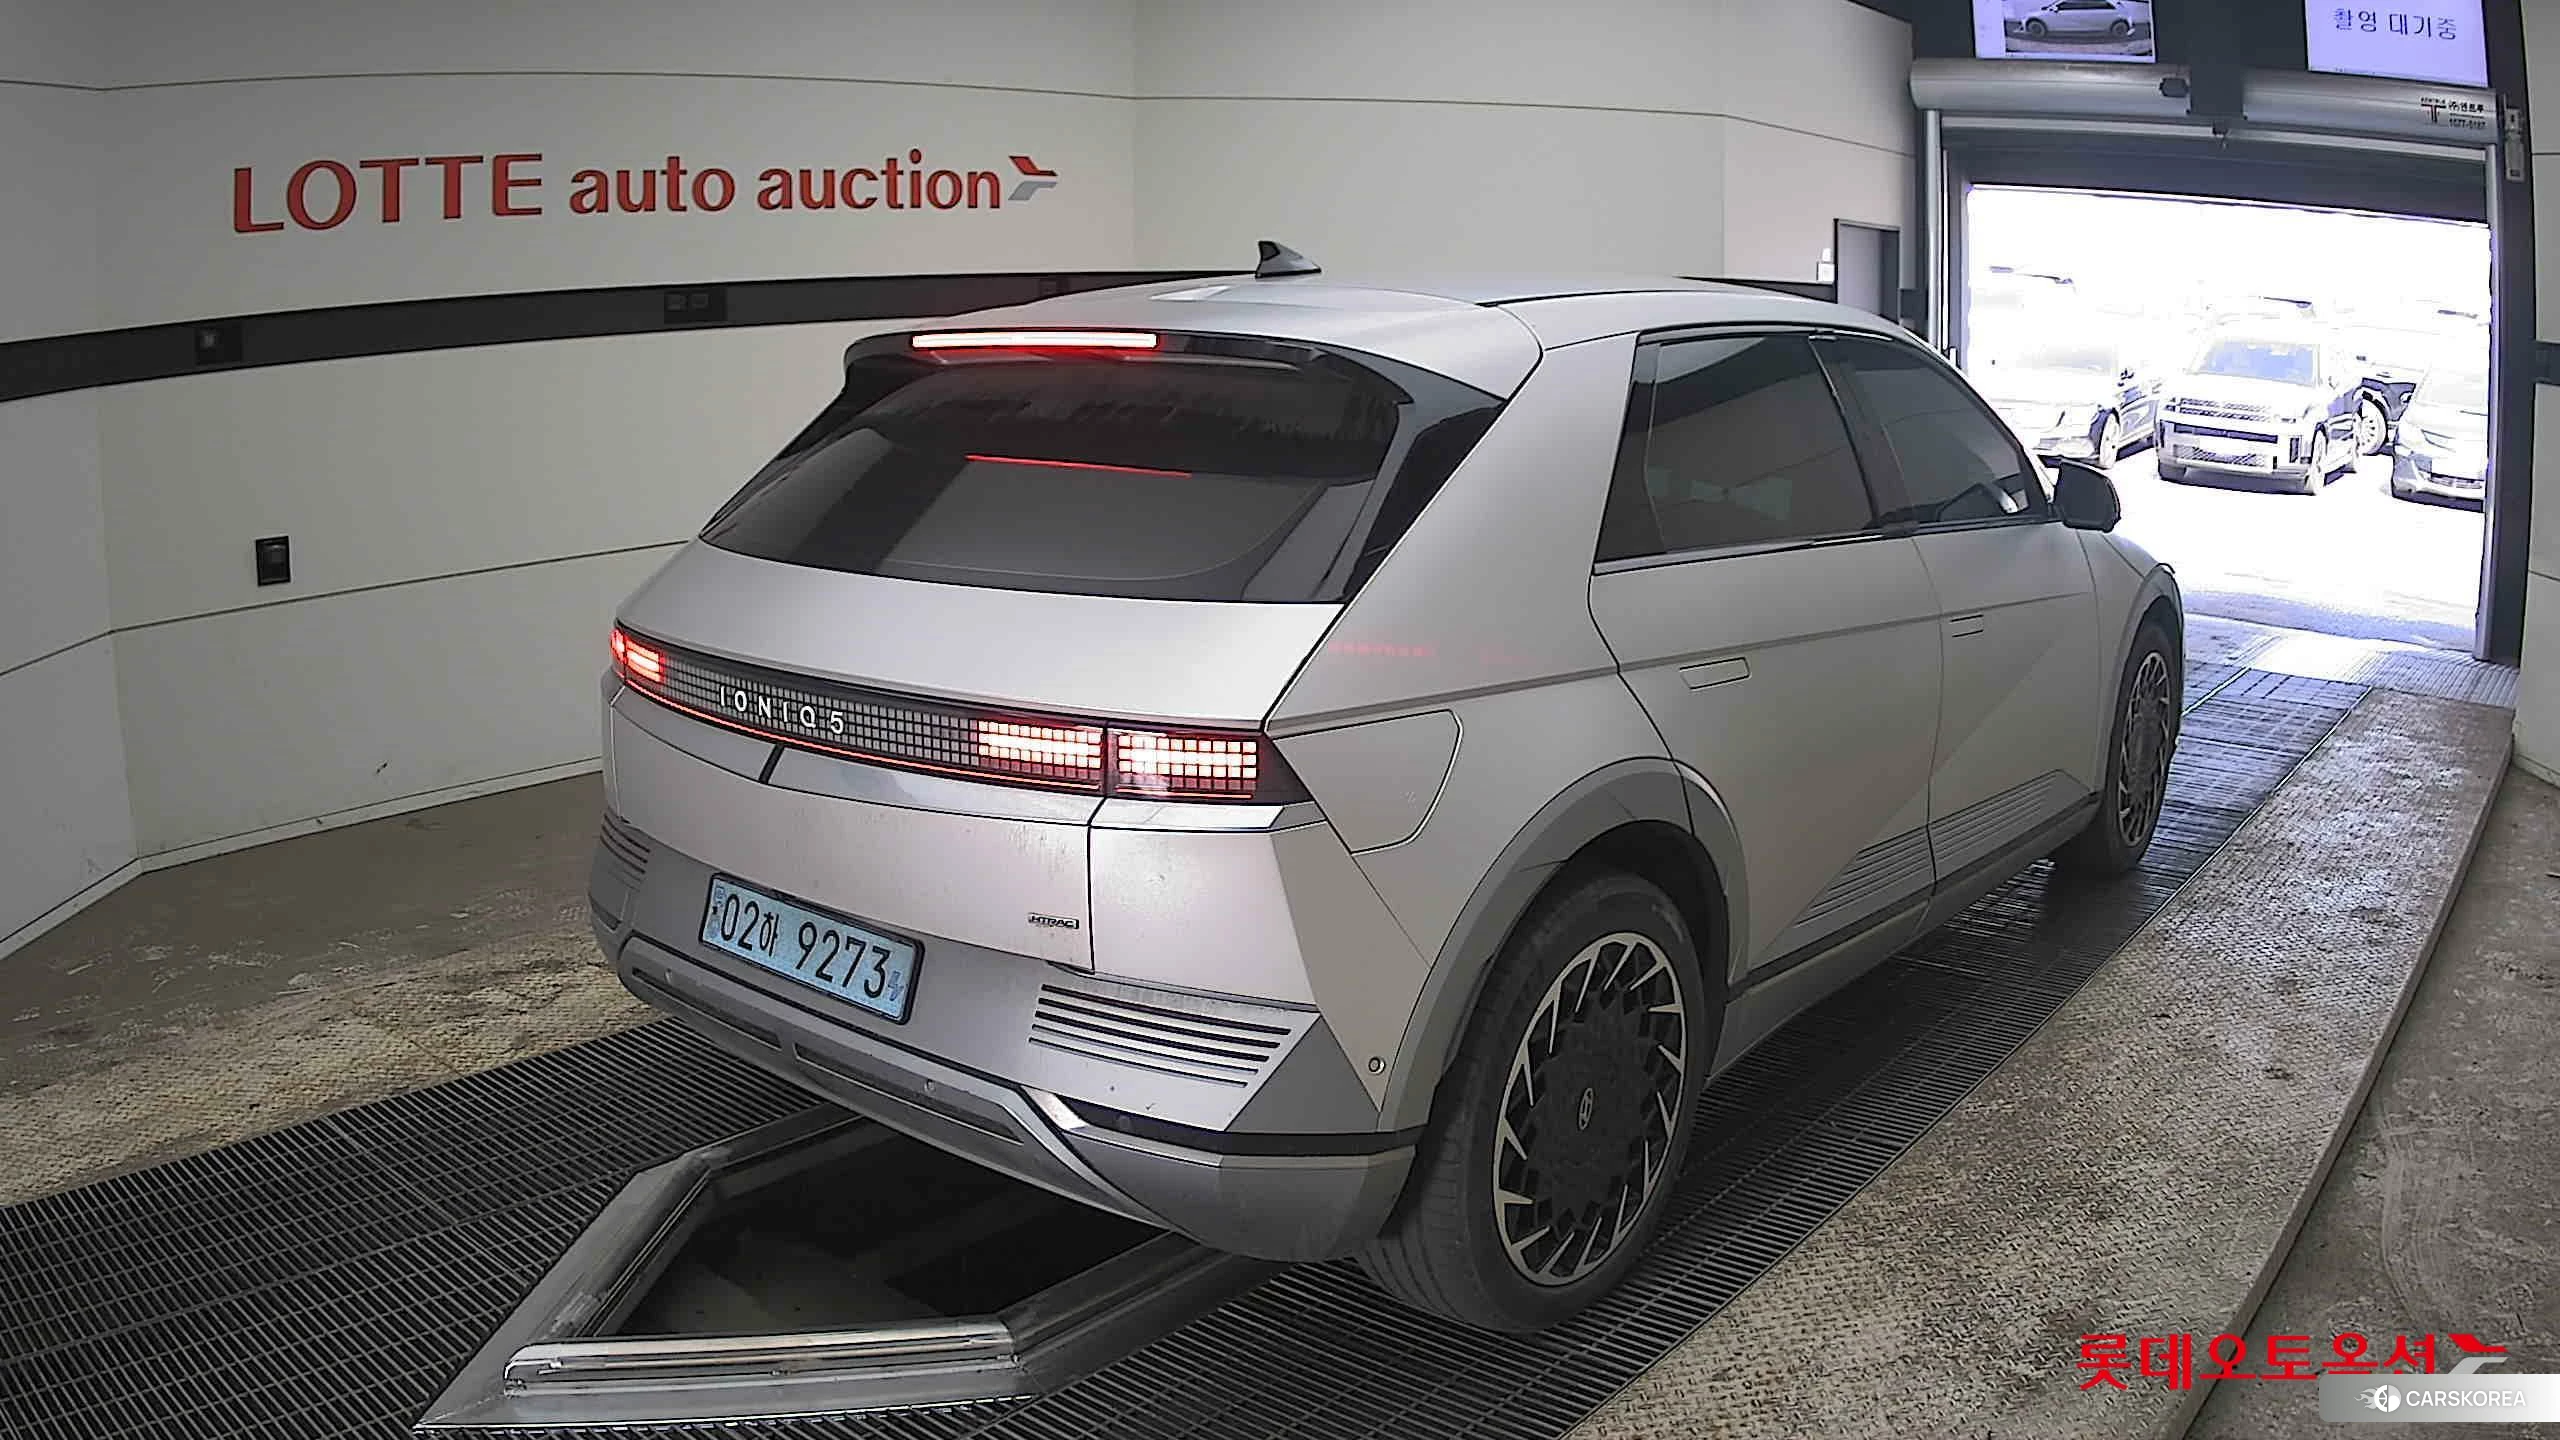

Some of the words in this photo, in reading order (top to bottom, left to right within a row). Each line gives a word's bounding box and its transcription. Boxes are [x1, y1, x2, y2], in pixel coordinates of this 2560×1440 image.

[2389, 13, 2457, 40] 대기중
[233, 153, 543, 232] LOTTE
[569, 156, 735, 213] auto
[757, 149, 1002, 212] auction
[720, 685, 817, 729] IONIQ
[830, 710, 845, 735] 5
[720, 894, 779, 957] 02하
[795, 922, 891, 999] 9273
[1027, 915, 1076, 929] HTRAC
